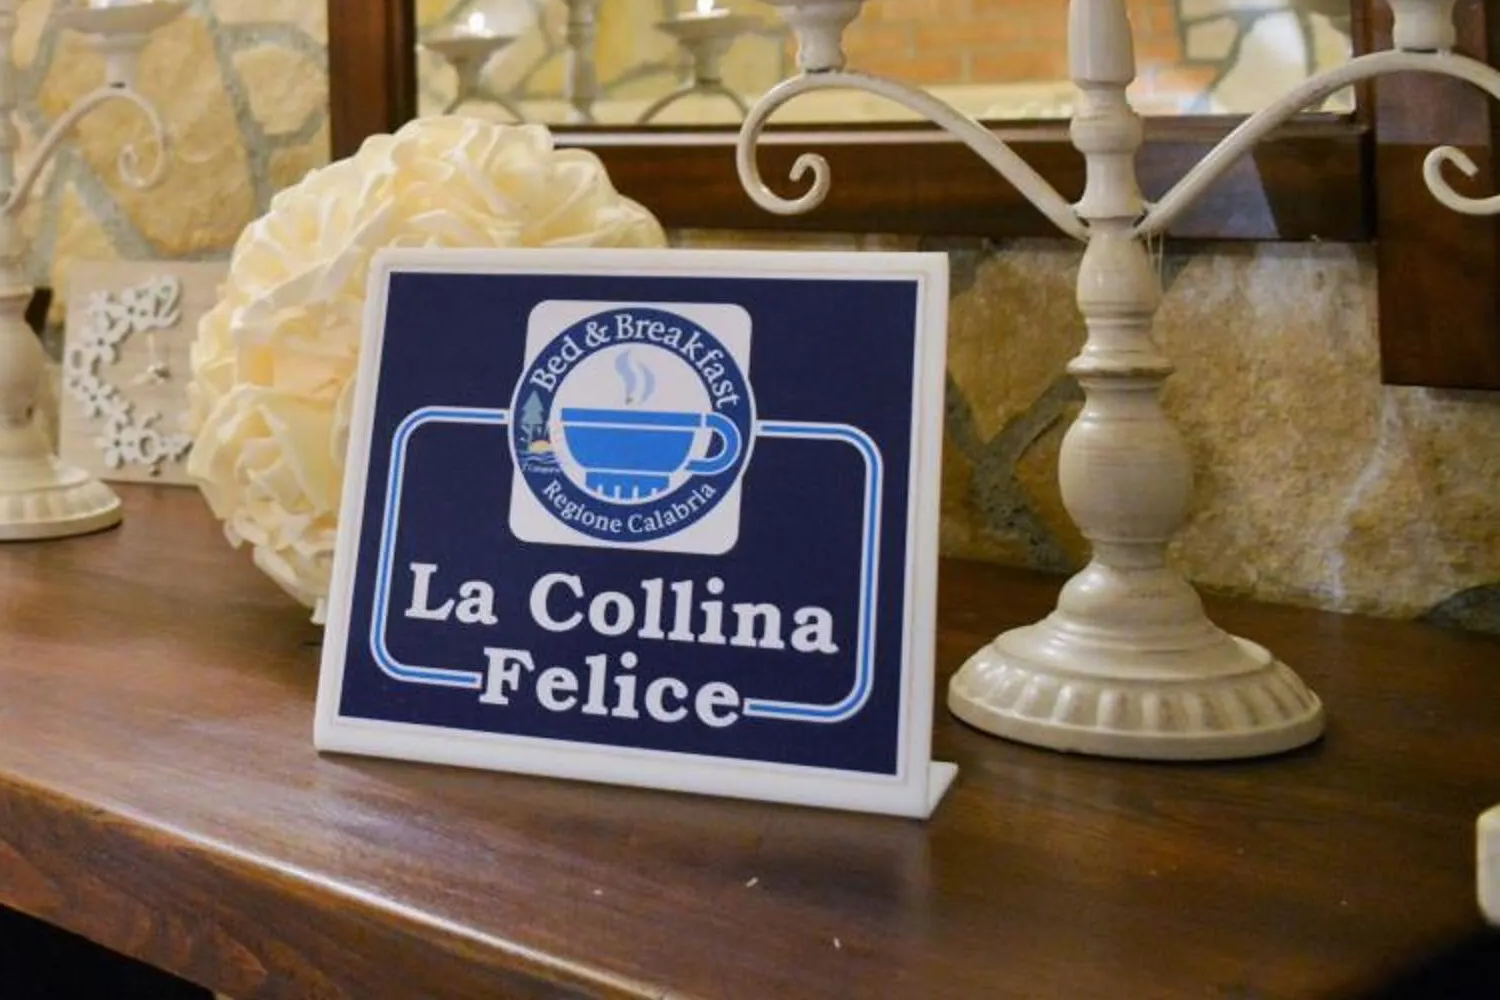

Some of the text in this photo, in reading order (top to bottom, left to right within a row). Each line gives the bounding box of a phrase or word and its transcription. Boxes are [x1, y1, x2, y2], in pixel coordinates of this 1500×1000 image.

[529, 313, 741, 409] Bed & Breakfast
[541, 479, 717, 534] Regione Calabria
[404, 562, 839, 654] La Collina
[479, 646, 740, 728] Felice
